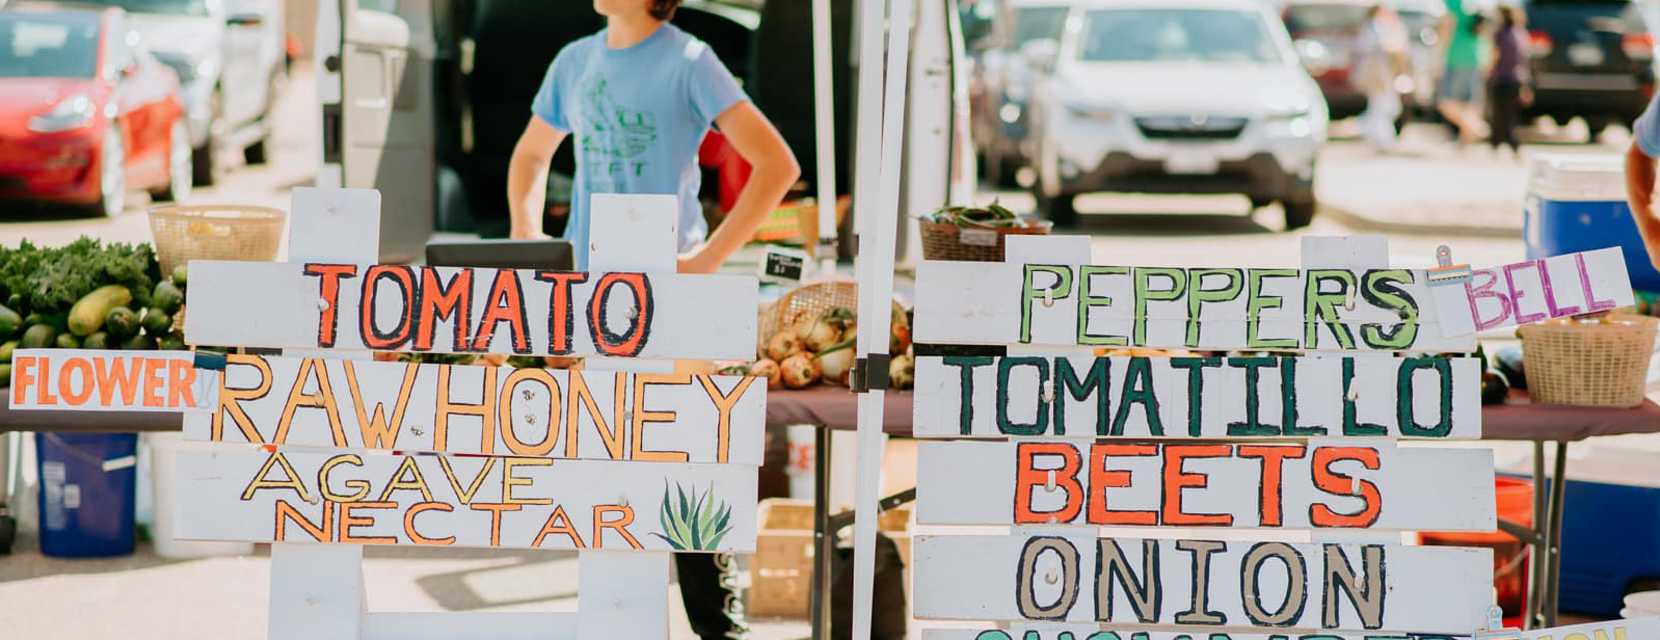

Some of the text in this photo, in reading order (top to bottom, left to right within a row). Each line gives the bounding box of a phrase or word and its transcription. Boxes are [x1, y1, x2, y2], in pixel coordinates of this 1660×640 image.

[303, 263, 654, 357] TOMATO
[1018, 264, 1419, 349] PEPPERS
[1464, 252, 1616, 331] BELL
[13, 357, 197, 408] FLOWER
[211, 354, 757, 463] RAW HONEY
[943, 356, 1453, 436] TOMATILLO
[241, 452, 553, 504] AGAVE
[1014, 442, 1382, 527] BEETS
[274, 500, 644, 550] NECTAR
[1016, 536, 1387, 629] ONION
